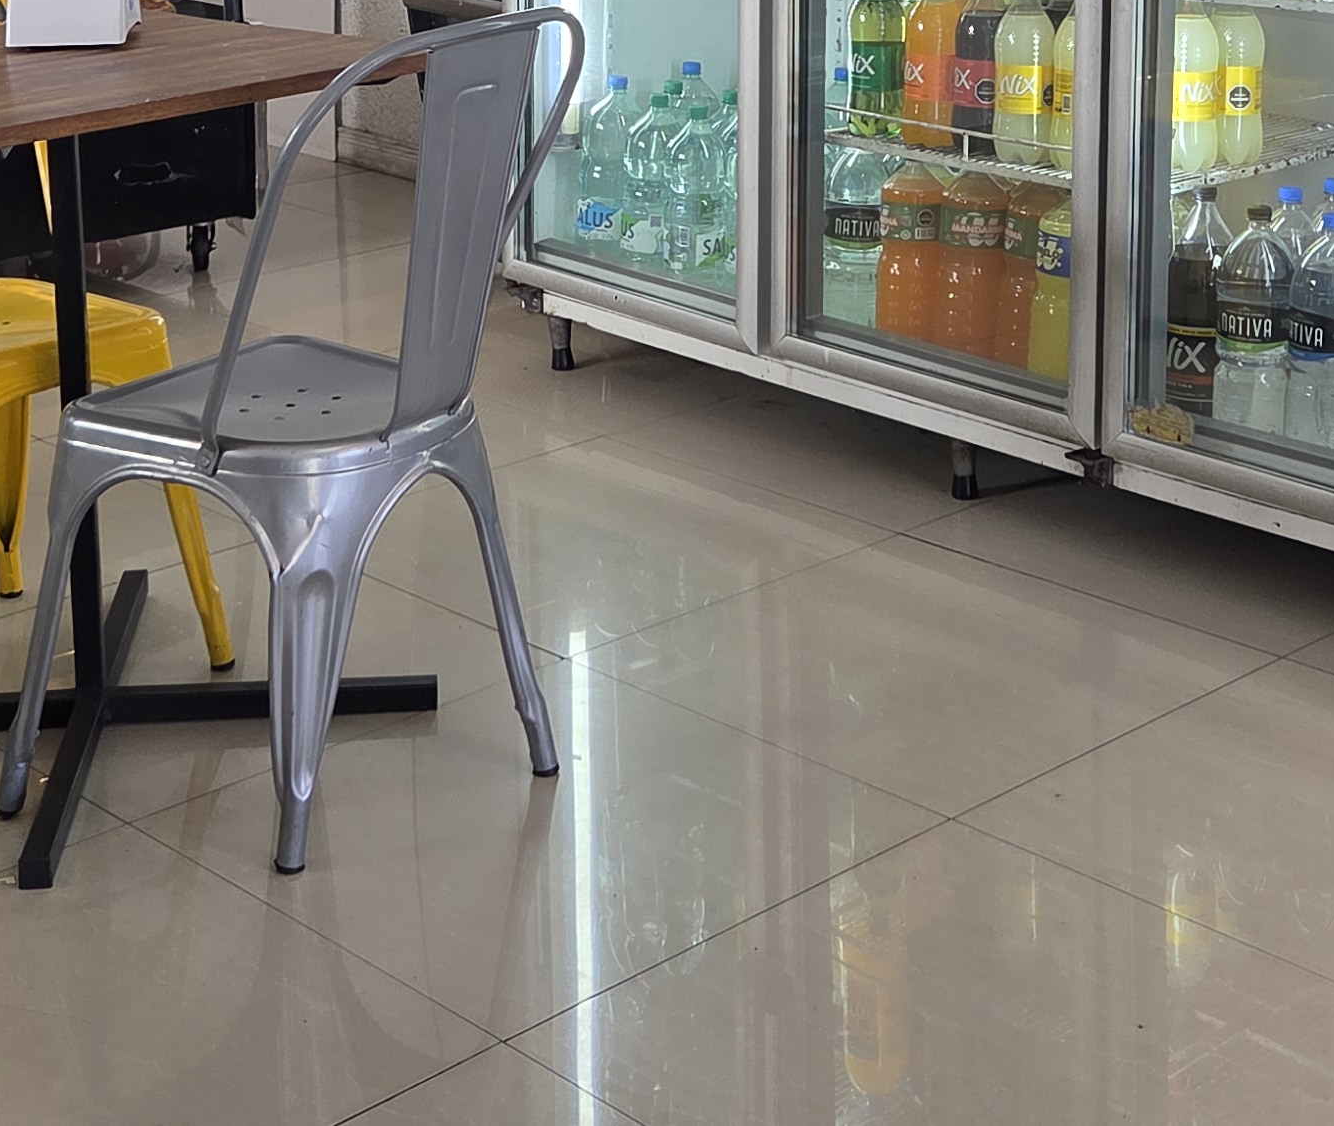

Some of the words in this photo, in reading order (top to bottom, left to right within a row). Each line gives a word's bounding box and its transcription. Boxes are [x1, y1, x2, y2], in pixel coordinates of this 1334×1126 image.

[576, 207, 614, 231] ALUS
[1221, 312, 1273, 338] NATIVA
[1289, 319, 1324, 348] TIVA
